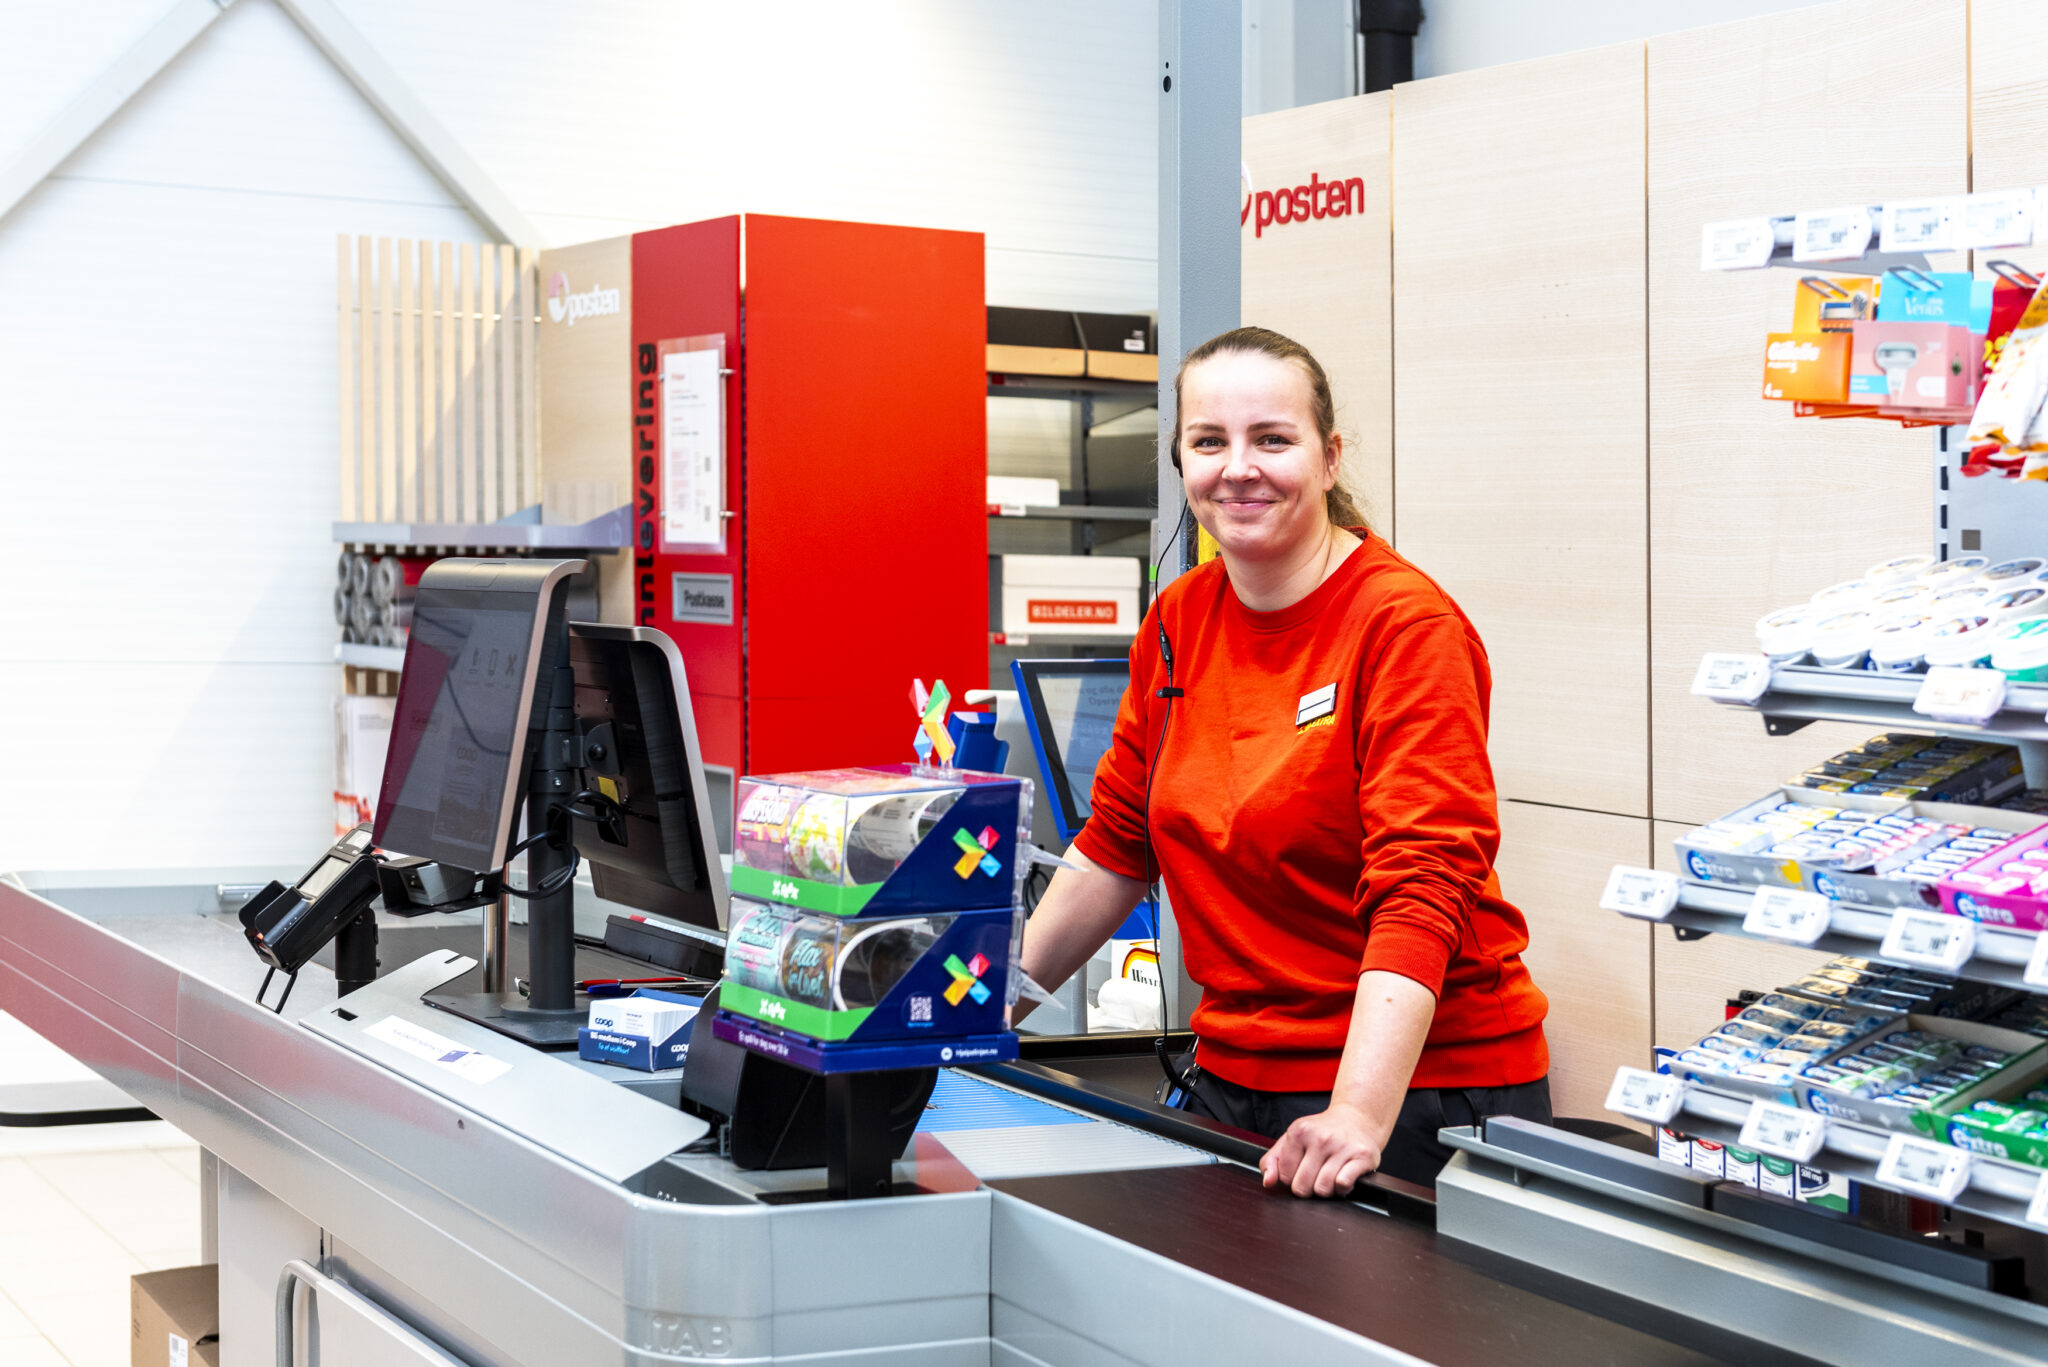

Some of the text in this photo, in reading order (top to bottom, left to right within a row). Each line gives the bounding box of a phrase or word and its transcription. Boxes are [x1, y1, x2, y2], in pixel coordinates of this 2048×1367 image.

[1255, 172, 1364, 238] posten
[567, 284, 620, 326] posten
[635, 343, 657, 628] nnlevering
[684, 590, 725, 608] Postkasse
[1032, 605, 1115, 619] BILDELER.NO
[1957, 896, 2016, 924] extra
[595, 1017, 613, 1028] coop
[1811, 1095, 1861, 1122] extra
[1951, 1128, 2009, 1160] extra
